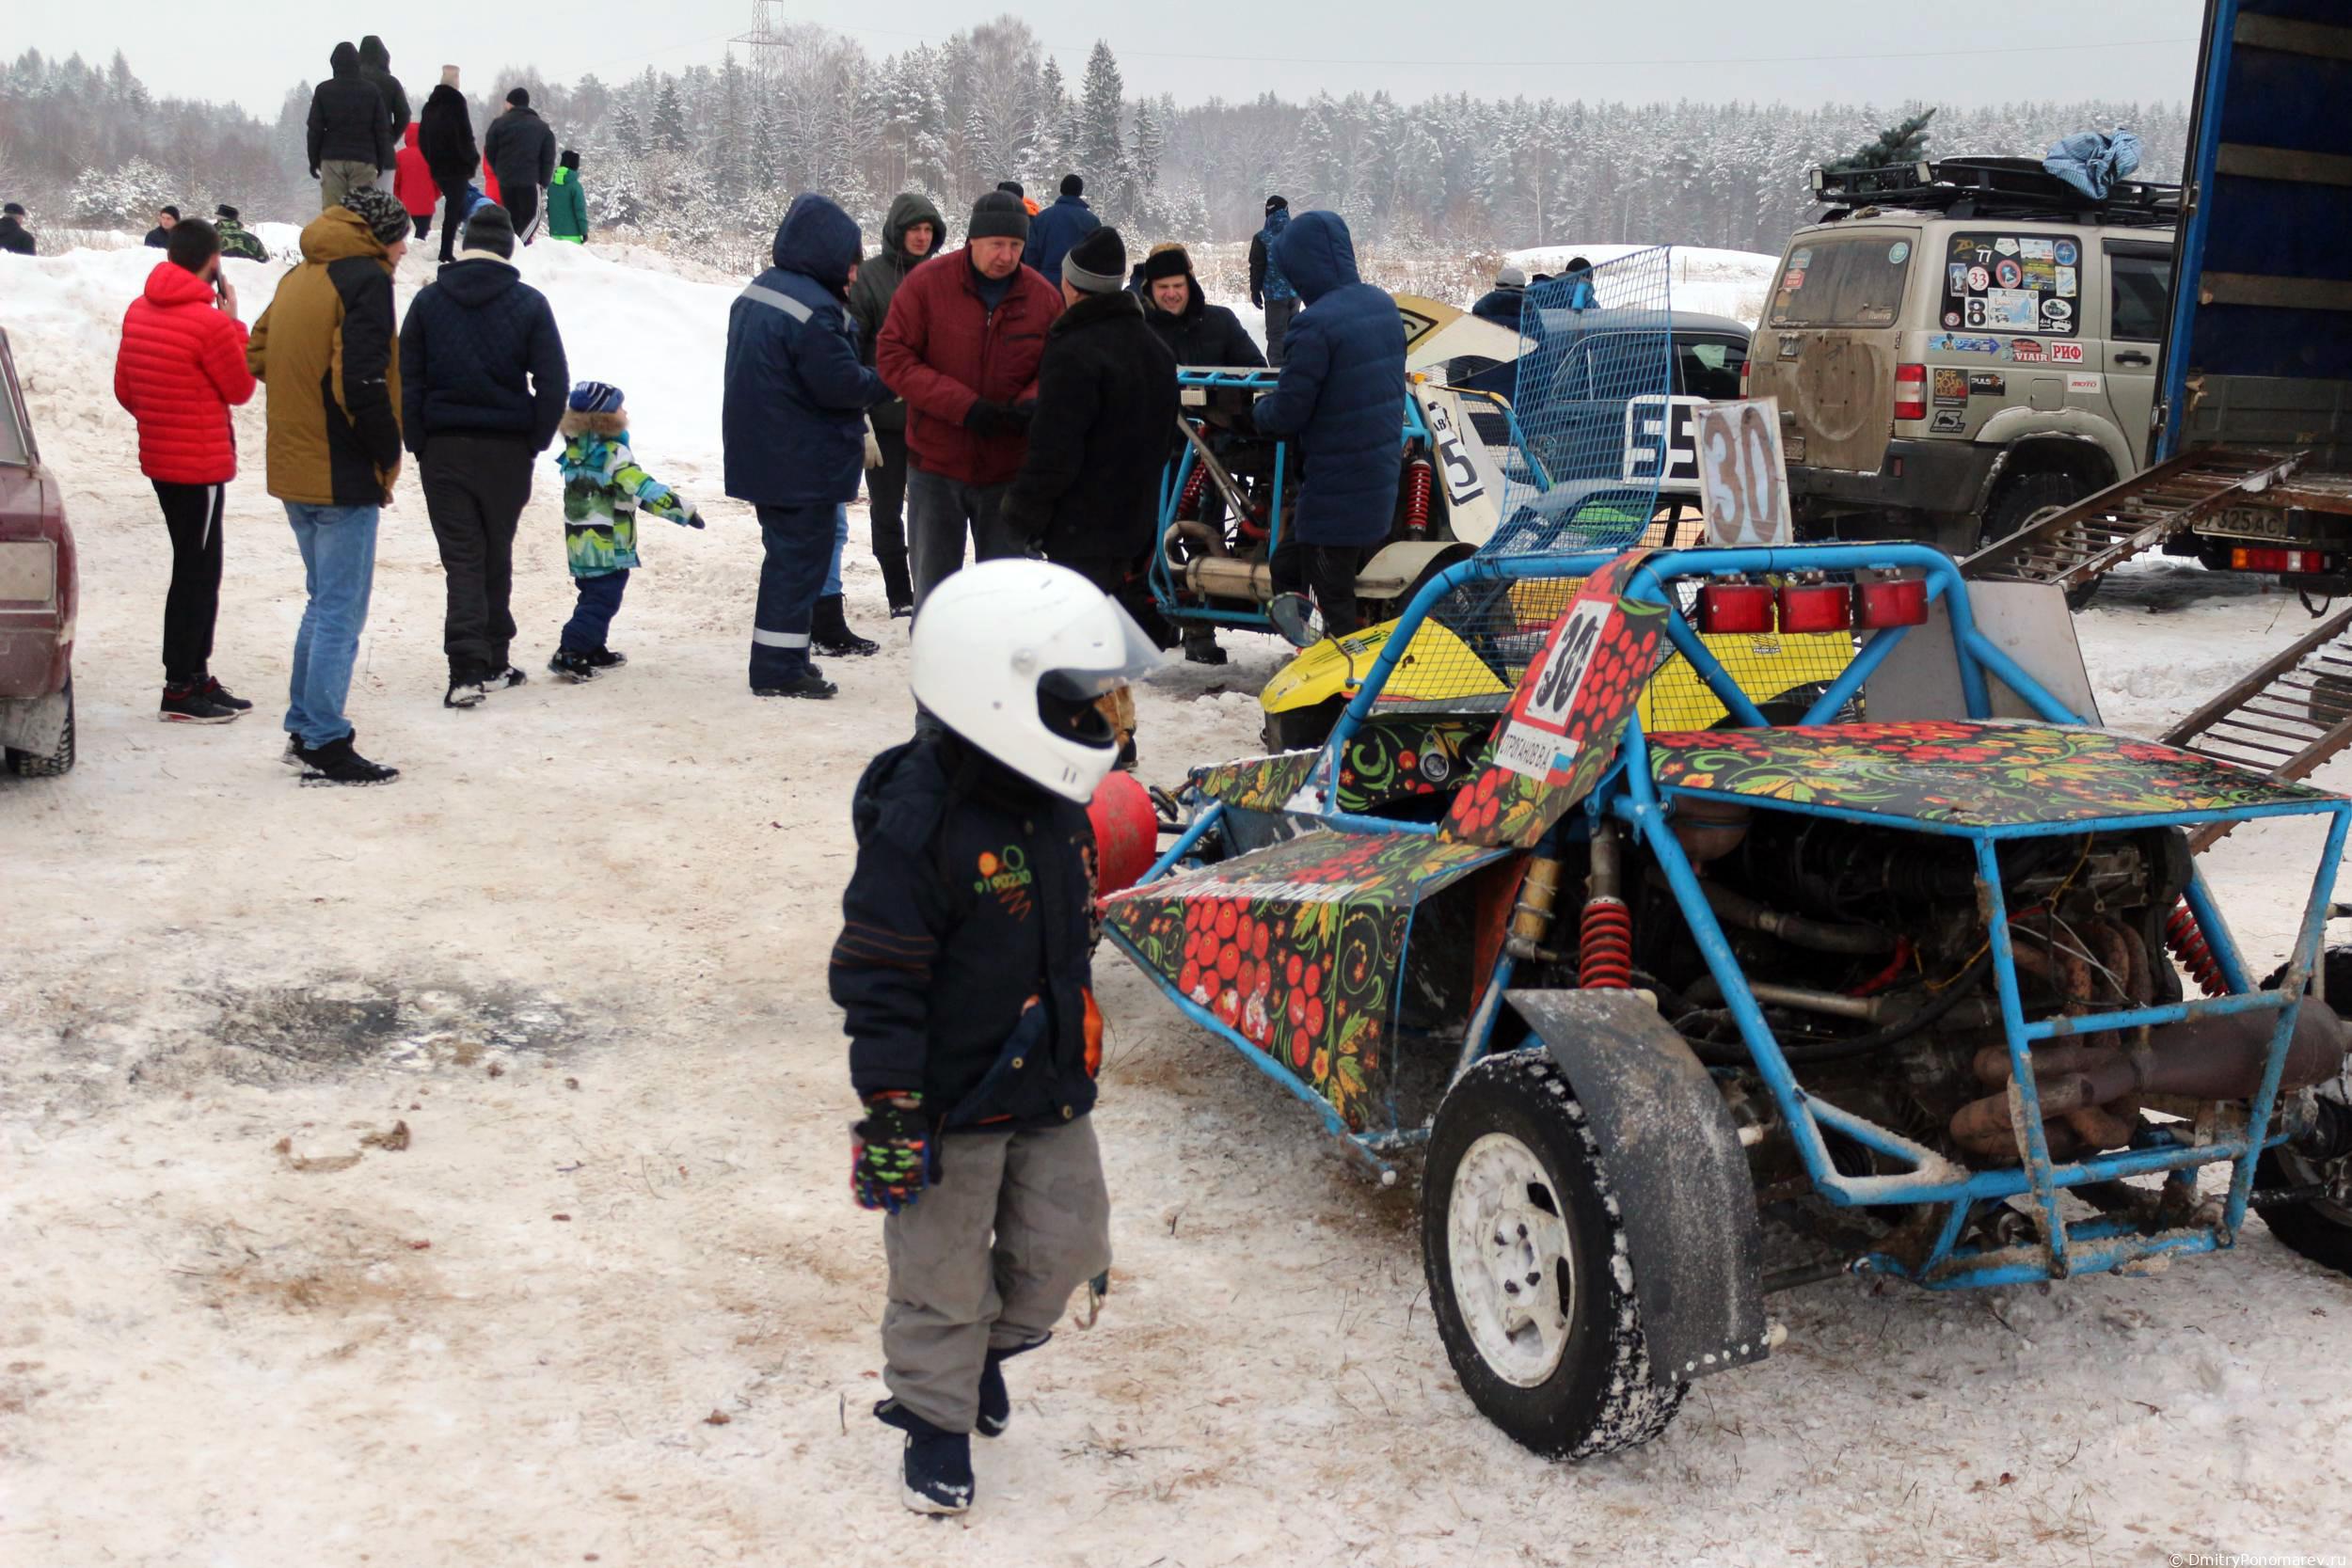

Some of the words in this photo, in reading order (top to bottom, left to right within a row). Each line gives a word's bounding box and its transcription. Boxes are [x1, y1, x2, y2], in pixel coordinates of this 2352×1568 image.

[1971, 272, 1987, 289] 33
[1967, 298, 1986, 326] 8
[2015, 353, 2048, 362] VIAIR
[2053, 344, 2082, 360] РИФ
[1440, 438, 1478, 487] 5
[1704, 406, 1778, 543] 30
[1535, 613, 1599, 712] 30
